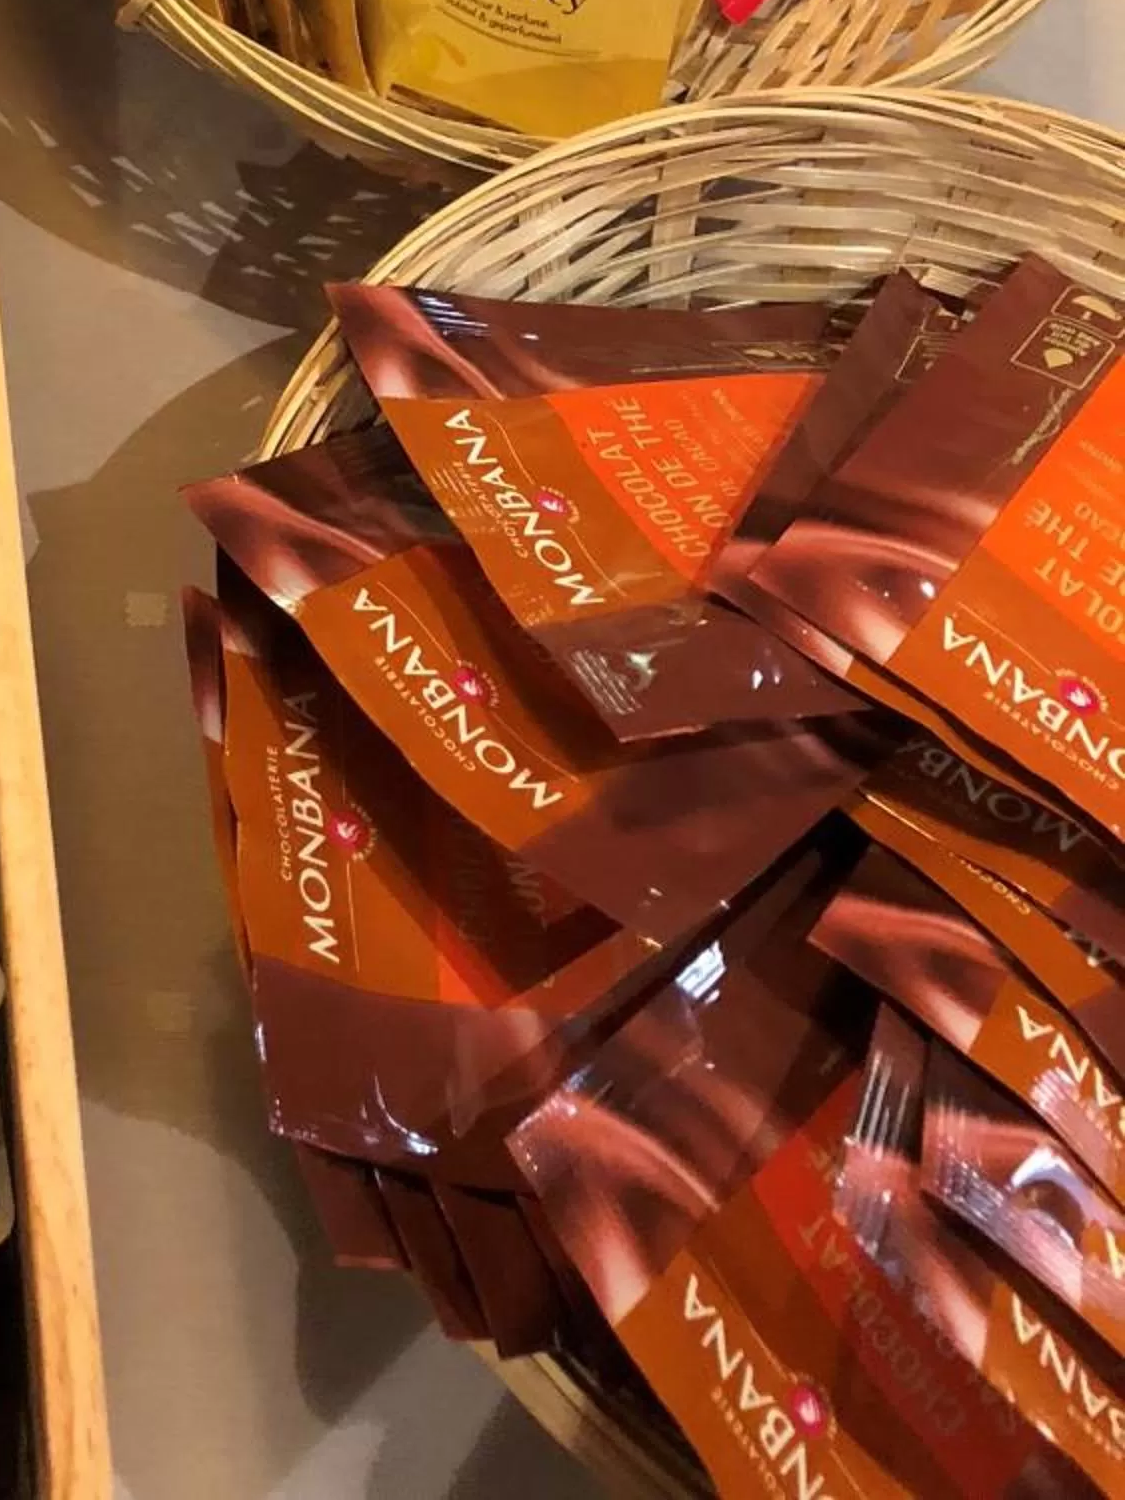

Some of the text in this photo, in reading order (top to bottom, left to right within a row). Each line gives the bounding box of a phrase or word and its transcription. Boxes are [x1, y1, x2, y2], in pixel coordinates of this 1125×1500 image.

[445, 409, 605, 606] MONBANA
[587, 426, 712, 561] CHOCOLAT
[352, 587, 564, 812] MONBANA
[373, 654, 477, 773] CHOCOLATERIE
[943, 615, 1125, 780] ONBANA
[266, 743, 293, 883] CHOCOLATERIE
[283, 691, 341, 965] MONBANA
[683, 1273, 825, 1500] NBANA
